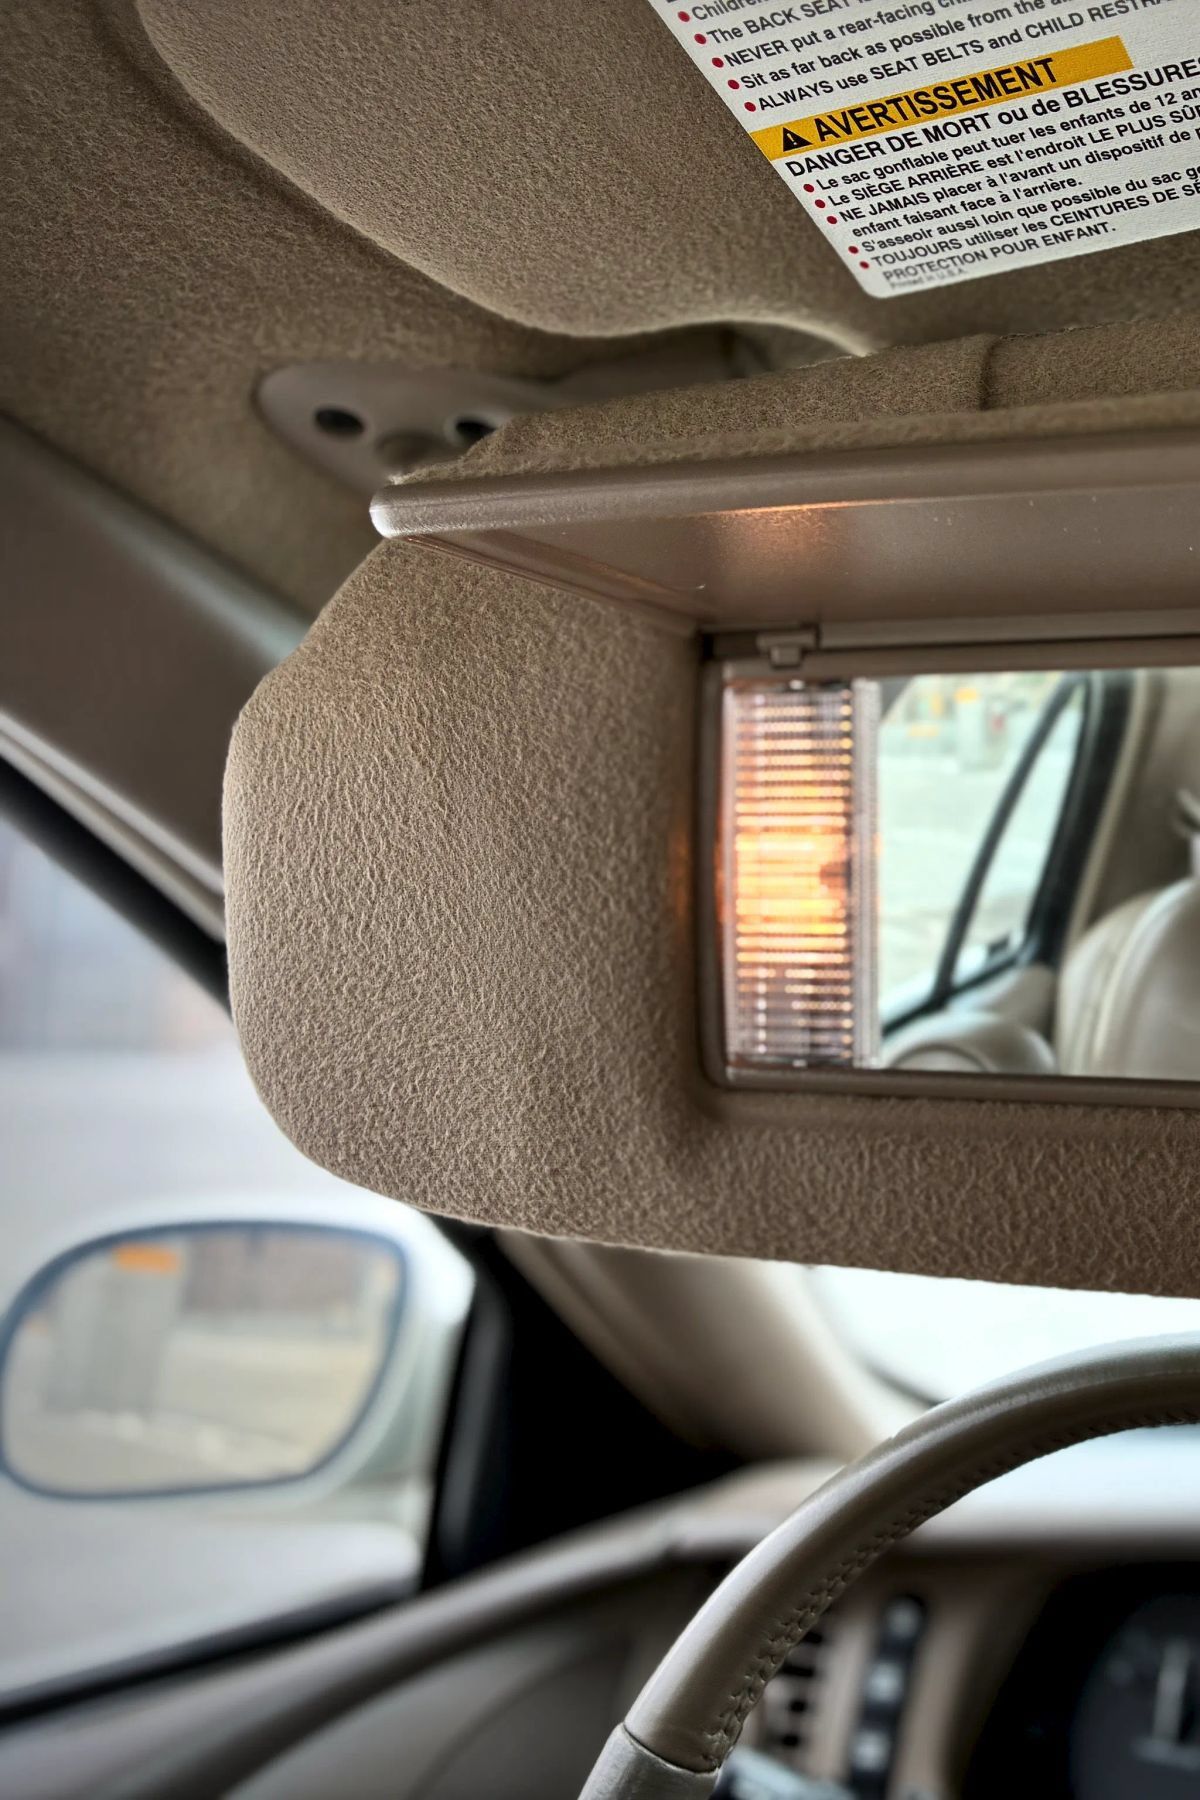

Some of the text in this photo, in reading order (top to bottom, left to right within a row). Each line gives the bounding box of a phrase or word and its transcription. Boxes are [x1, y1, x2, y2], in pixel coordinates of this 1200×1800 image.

[691, 0, 769, 20] Childre
[706, 27, 743, 43] The
[743, 7, 801, 34] BACK
[723, 1, 935, 67] NEVER put a rear-facing
[740, 0, 1045, 88] Sit as far back as possible from the
[758, 80, 834, 110] ALWAYS
[835, 73, 868, 89] use
[869, 56, 918, 79] SEAT
[921, 39, 984, 66] BELTS
[987, 28, 1023, 49] and
[1025, 12, 1084, 38] CHILD
[813, 57, 1056, 142] AVERTISSEMENT
[785, 140, 887, 176] DANGER
[885, 131, 923, 152] DE
[921, 112, 991, 143] MORT
[997, 107, 1028, 124] ou
[1031, 98, 1061, 116] de
[816, 178, 839, 190] Le
[841, 170, 870, 184] sac
[872, 151, 949, 179] gonflable
[951, 139, 991, 161] peut
[991, 131, 1025, 148] tuer
[1028, 125, 1056, 139] les
[1059, 107, 1125, 131] enfants
[1128, 100, 1151, 114] de
[1154, 92, 1178, 106] 12
[827, 194, 850, 206] Le
[851, 179, 905, 200] SIÈGE
[907, 159, 984, 188] ARRIÈRE
[986, 153, 1014, 168] est
[1014, 135, 1087, 161] l'endroit
[1087, 127, 1114, 143] LE
[1115, 114, 1166, 137] PLUS
[838, 207, 866, 222] NE
[868, 191, 930, 215] JAMAIS
[932, 180, 982, 203] placer
[985, 175, 998, 187] à
[998, 161, 1056, 184] l'avant
[1058, 157, 1082, 170] un
[1084, 133, 1164, 164] dispositif
[1168, 130, 1191, 143] de
[852, 177, 1082, 237] enfant faisant face à l'arrière.
[861, 228, 933, 252] S'asseoir
[936, 216, 980, 235] aussi
[980, 210, 1014, 224] loin
[1016, 203, 1047, 218] que
[1050, 185, 1121, 211] possible
[1125, 179, 1148, 191] du
[1151, 171, 1182, 185] sac
[871, 238, 962, 266] TOUJOURS
[964, 226, 1019, 246] utiliser
[1021, 221, 1048, 233] les
[1049, 195, 1150, 226] CEINTURES
[1151, 187, 1180, 203] DE
[883, 221, 1116, 280] PROTECTION POUR ENFANT.
